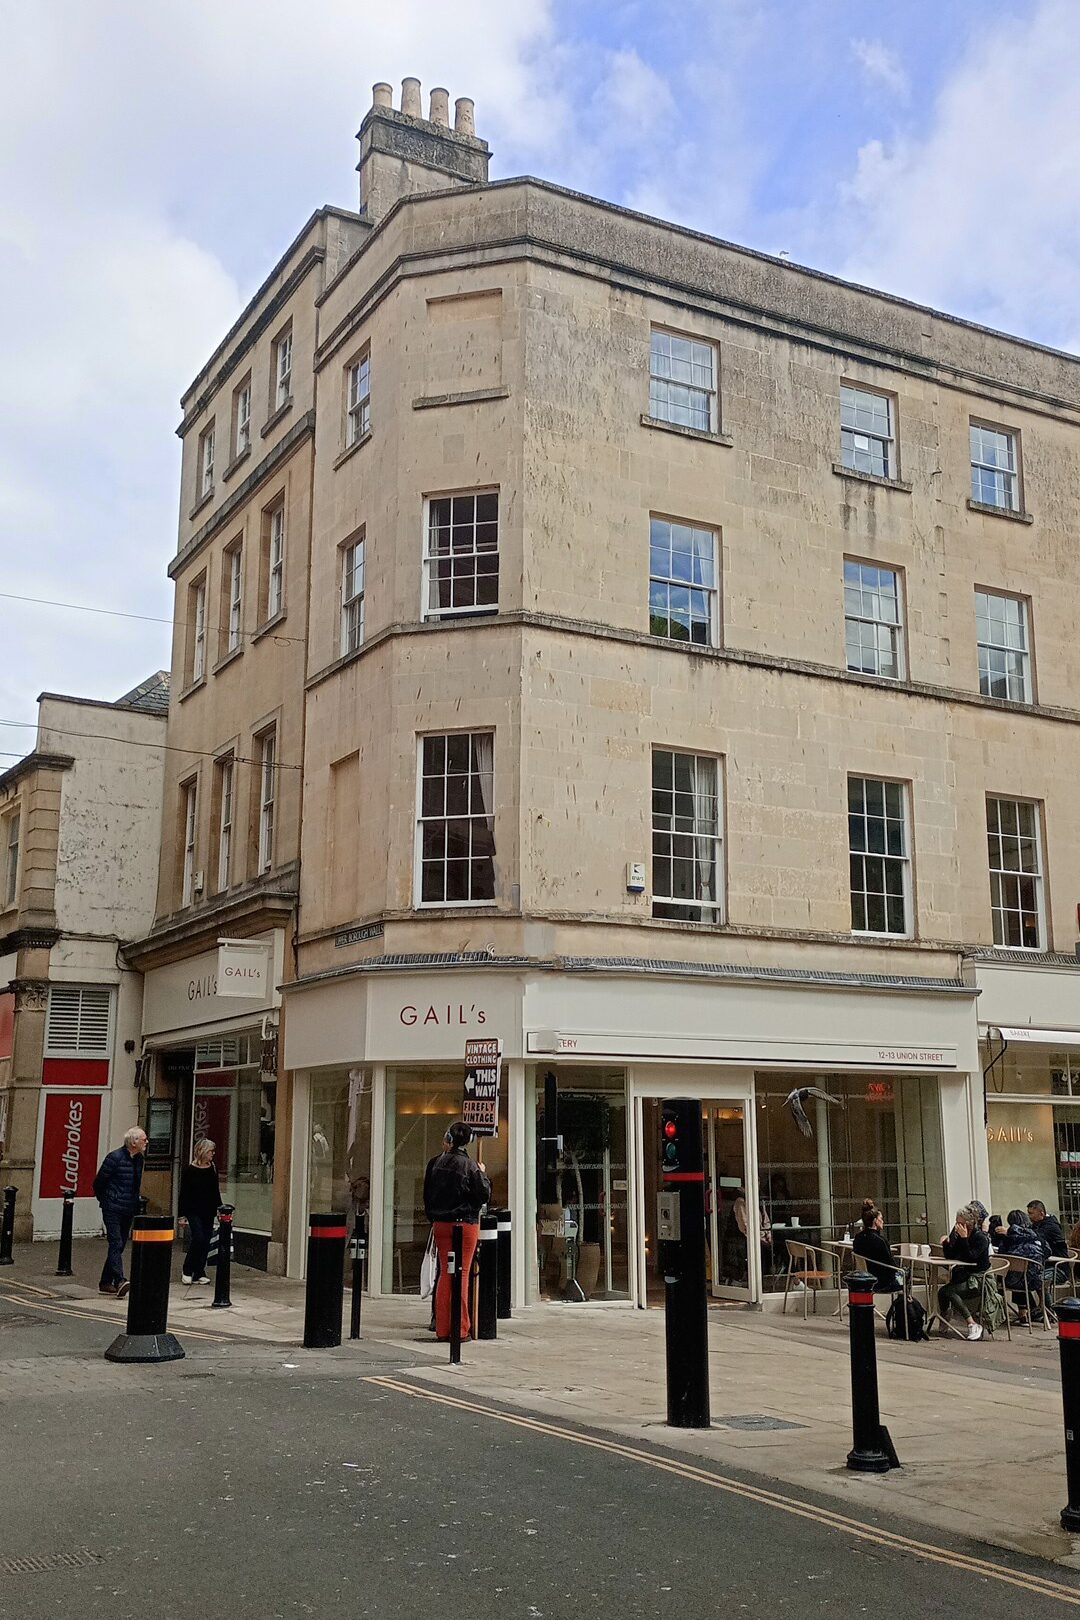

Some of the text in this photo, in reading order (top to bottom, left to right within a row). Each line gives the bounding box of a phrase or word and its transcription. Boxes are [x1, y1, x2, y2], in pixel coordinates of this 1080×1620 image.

[348, 928, 369, 942] BOROUGH
[369, 923, 385, 936] WALLS
[225, 967, 261, 978] GAIL's
[187, 974, 218, 1001] GAIL's
[400, 1004, 486, 1026] GAIL's
[466, 1043, 497, 1054] VINTAGE
[466, 1055, 497, 1064] CLOTHING
[878, 1051, 944, 1061] 12-13 UNION STREET
[475, 1069, 497, 1083] THIS
[475, 1084, 496, 1097] WAY!
[463, 1102, 495, 1112] FIREFLY
[463, 1112, 494, 1123] VINTAGE
[60, 1100, 83, 1194] Ladbrokes
